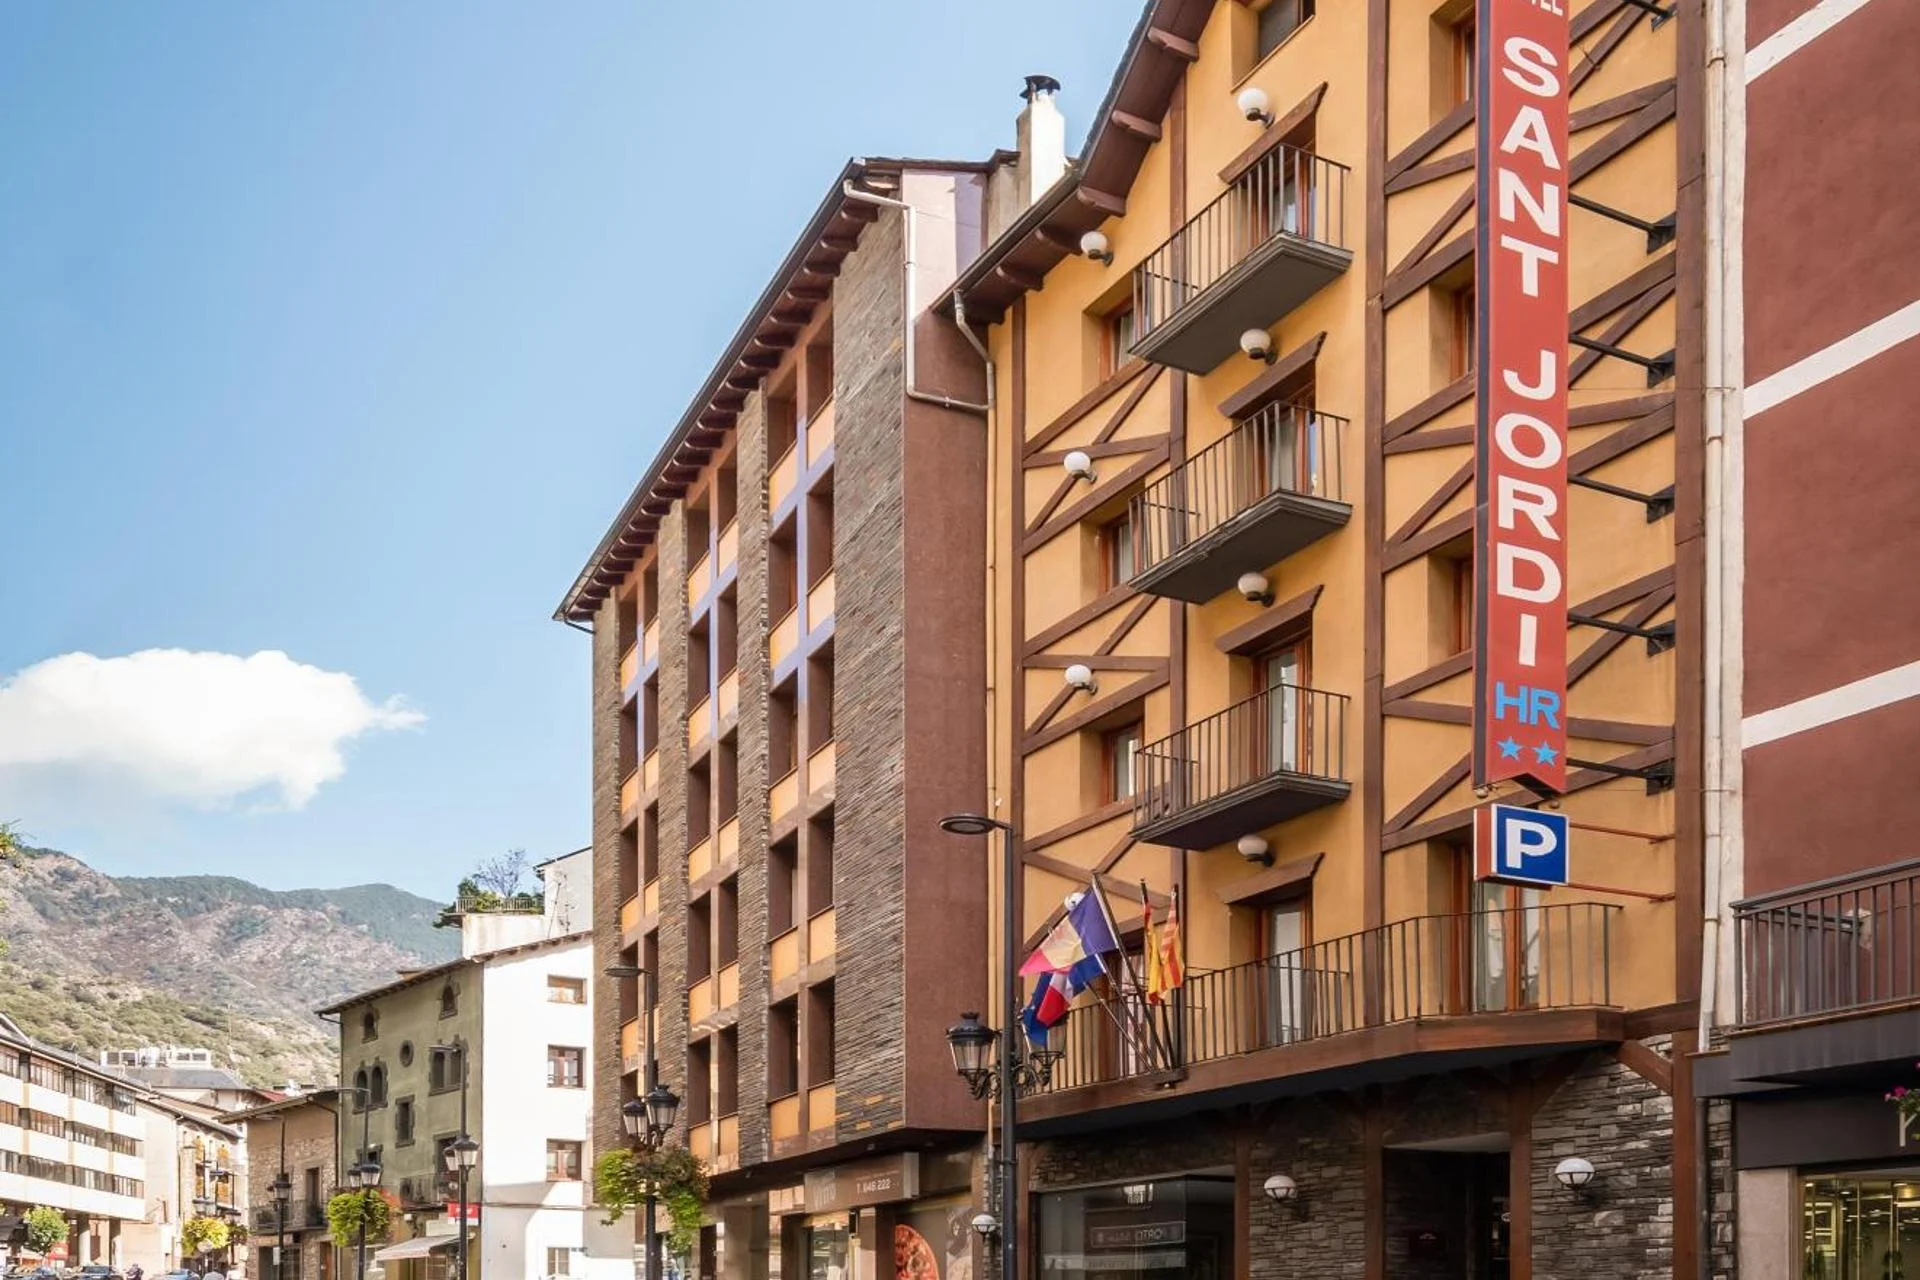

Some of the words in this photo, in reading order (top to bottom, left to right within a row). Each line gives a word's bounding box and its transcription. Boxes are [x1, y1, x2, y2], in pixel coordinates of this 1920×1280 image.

[1499, 36, 1561, 298] SANT
[1494, 349, 1562, 667] JORDI
[1494, 681, 1561, 730] HR
[1505, 817, 1558, 869] P
